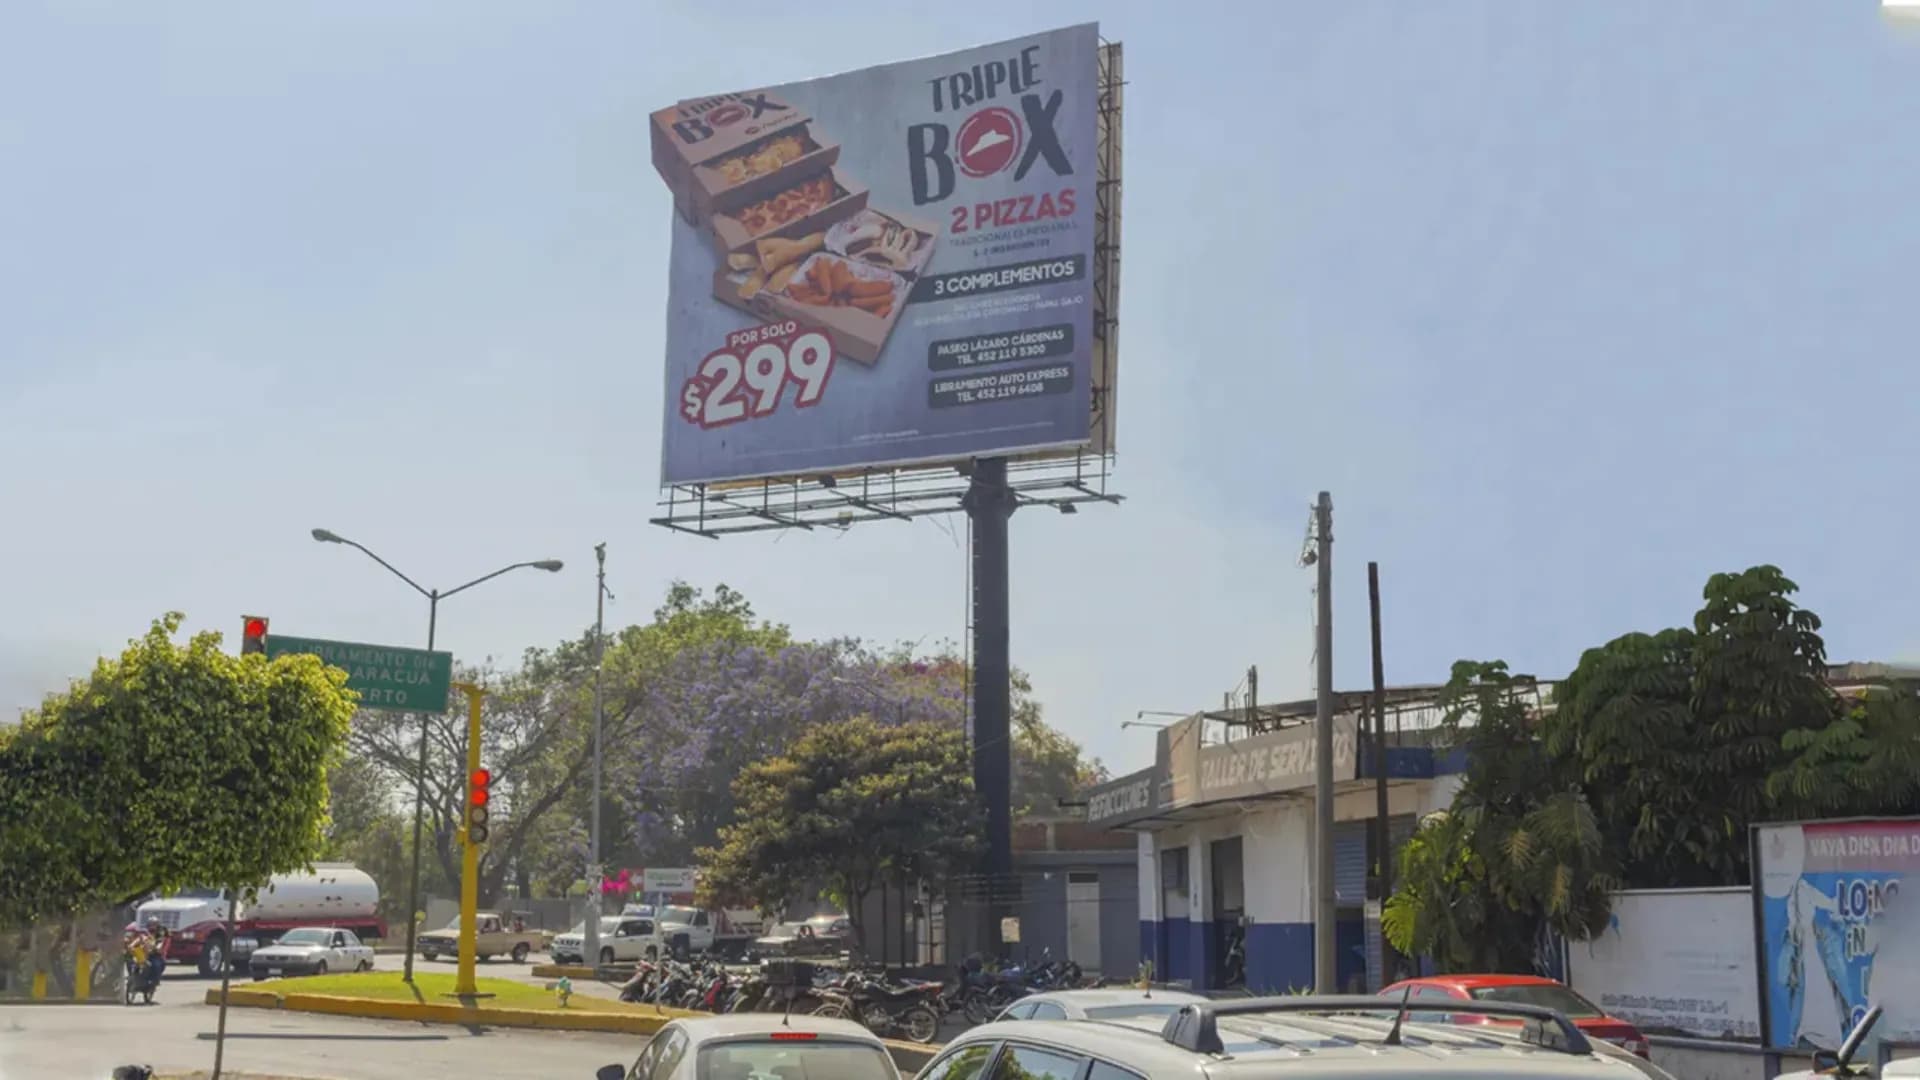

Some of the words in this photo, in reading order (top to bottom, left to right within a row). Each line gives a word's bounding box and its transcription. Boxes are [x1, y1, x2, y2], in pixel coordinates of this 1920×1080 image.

[925, 45, 1042, 112] TRIPLE
[908, 89, 1074, 206] BOX
[950, 205, 968, 234] 2
[974, 187, 1077, 230] PIZZAS
[934, 280, 944, 295] 3
[946, 261, 1074, 293] COMPLEMENTOS
[731, 331, 758, 347] POR
[761, 321, 797, 341] SOLO
[937, 342, 968, 356] PASEO
[978, 350, 996, 362] 452
[998, 348, 1018, 359] 119
[684, 332, 832, 425] $299
[935, 376, 998, 393] LIBRAMIENTO
[999, 373, 1025, 386] AUTO
[1027, 367, 1069, 382] EXPRESS
[977, 388, 996, 400] 452
[998, 385, 1017, 397] 119
[358, 687, 408, 705] ERTO
[1201, 753, 1246, 789] TALLER
[1248, 747, 1269, 781] DE
[1088, 778, 1150, 823] REFACCIONES
[1809, 836, 1846, 857] VAYA
